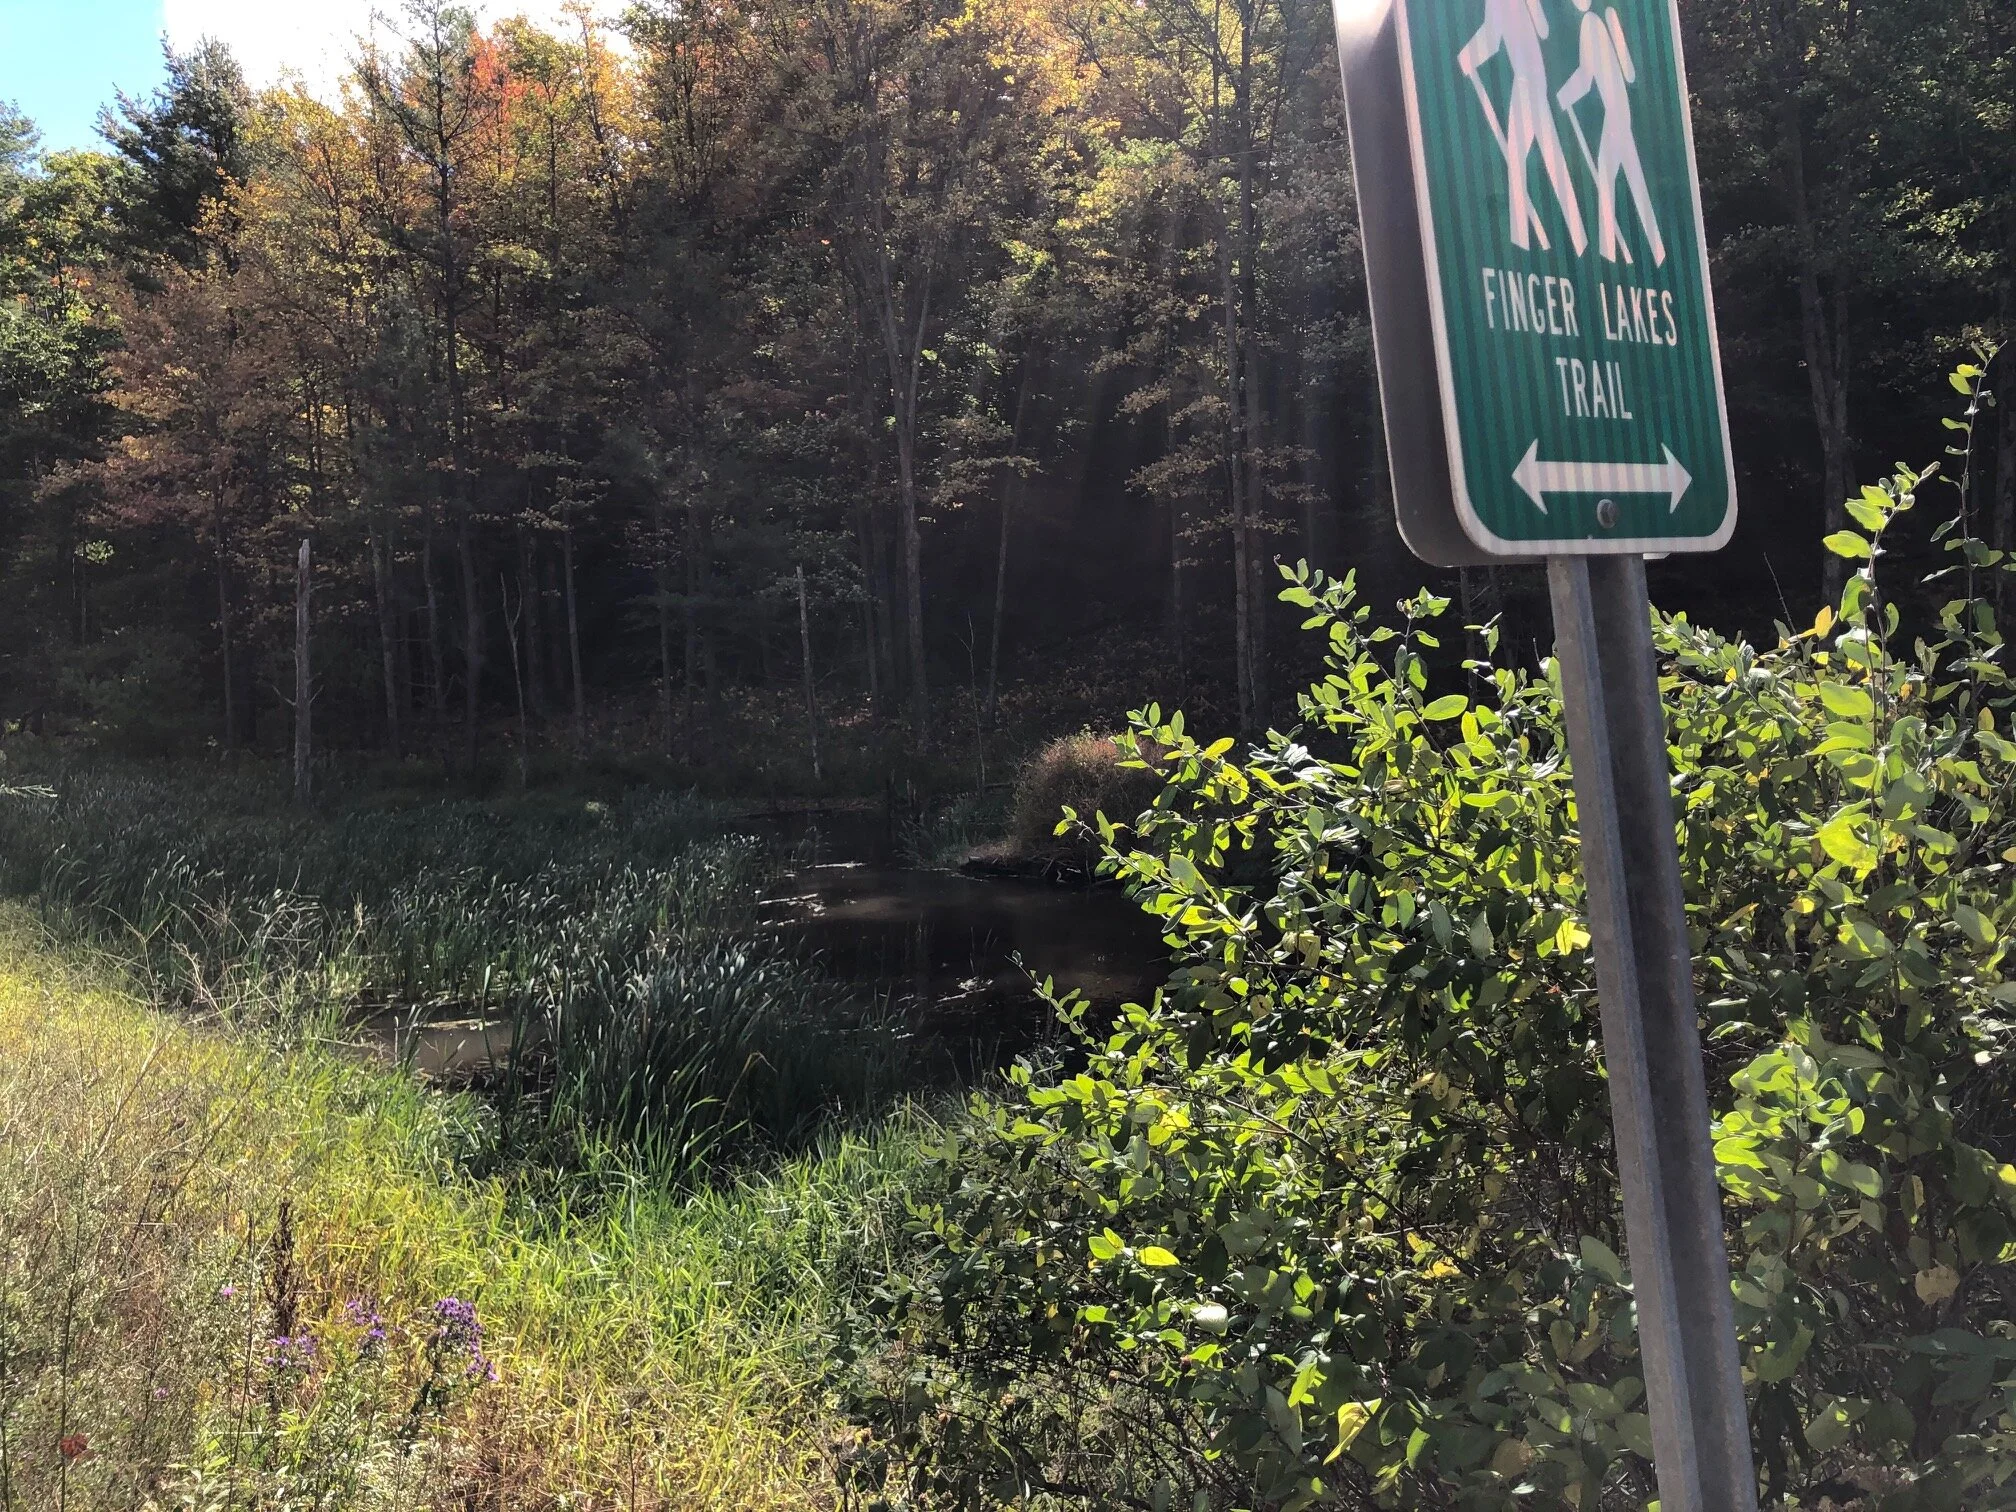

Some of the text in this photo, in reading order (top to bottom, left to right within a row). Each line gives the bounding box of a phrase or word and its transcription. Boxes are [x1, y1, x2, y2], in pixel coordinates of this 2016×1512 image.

[1482, 267, 1678, 347] FINGER LAKES
[1555, 356, 1633, 420] TRAIL
